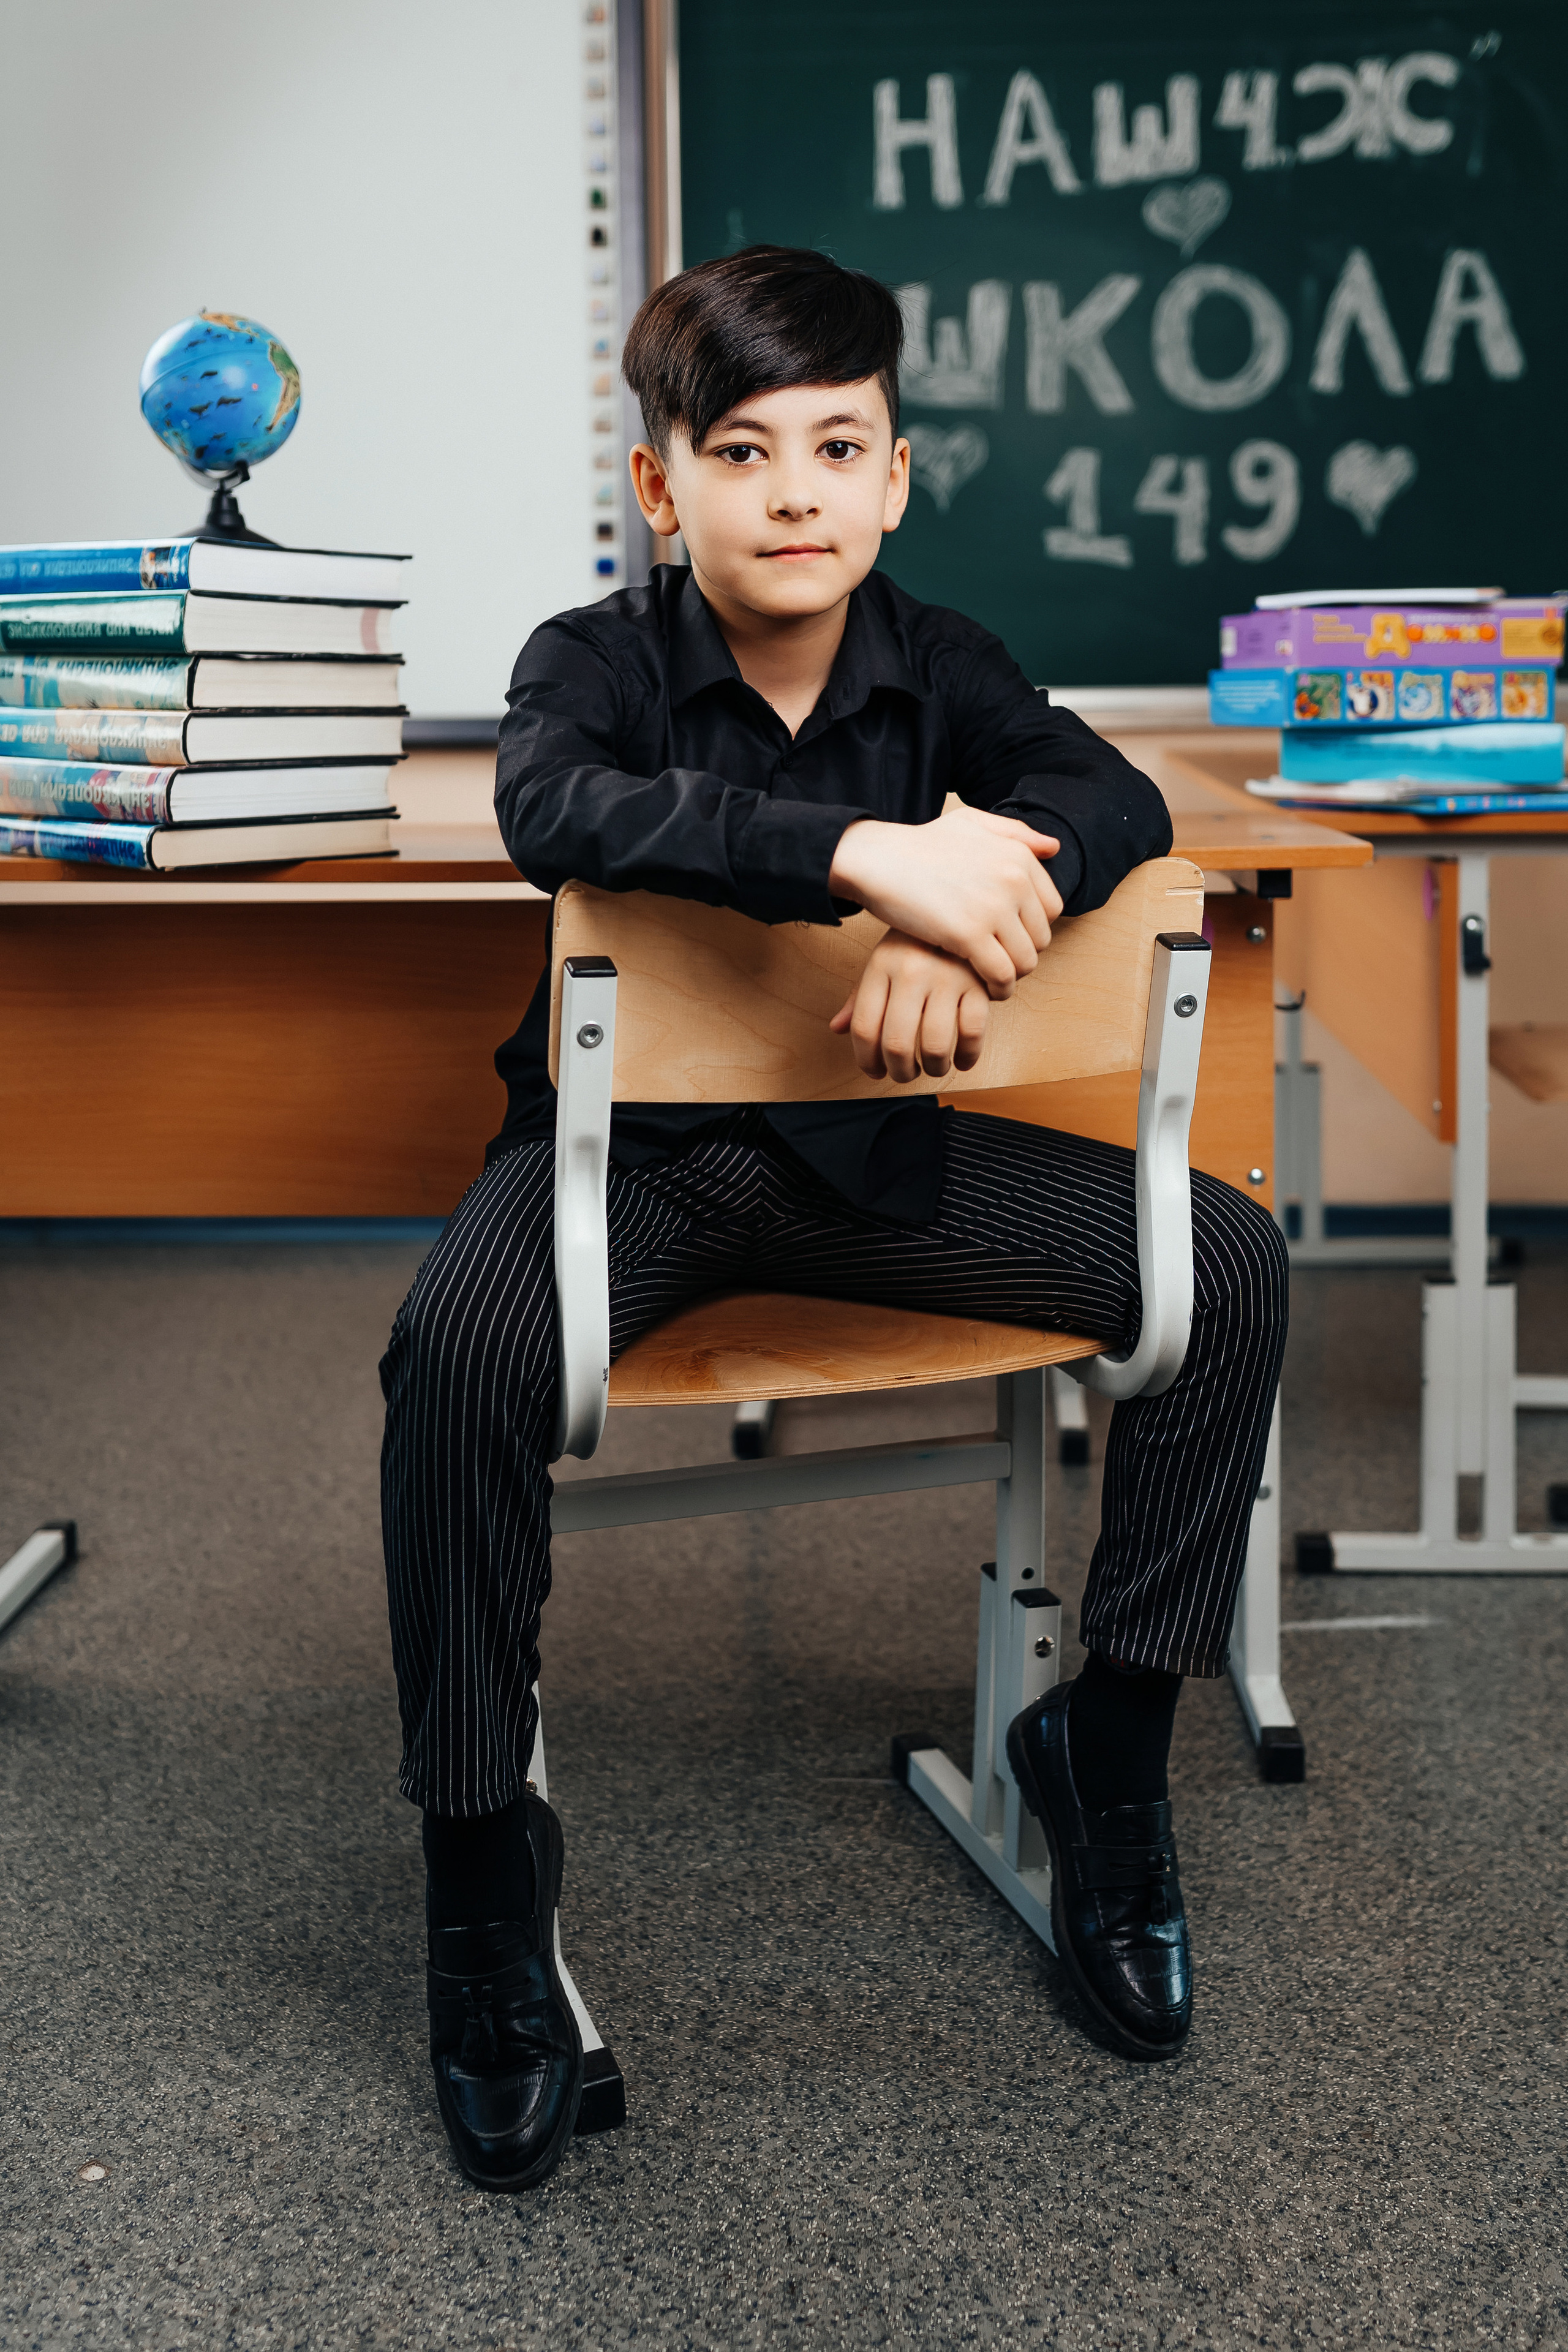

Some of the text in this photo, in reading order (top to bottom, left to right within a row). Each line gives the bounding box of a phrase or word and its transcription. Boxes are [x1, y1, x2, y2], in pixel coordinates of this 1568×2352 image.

[872, 69, 1200, 209] НАШ
[898, 246, 1528, 415] ШКОЛА
[1042, 437, 1301, 567] 149
[22, 725, 48, 744] ДЛЯ
